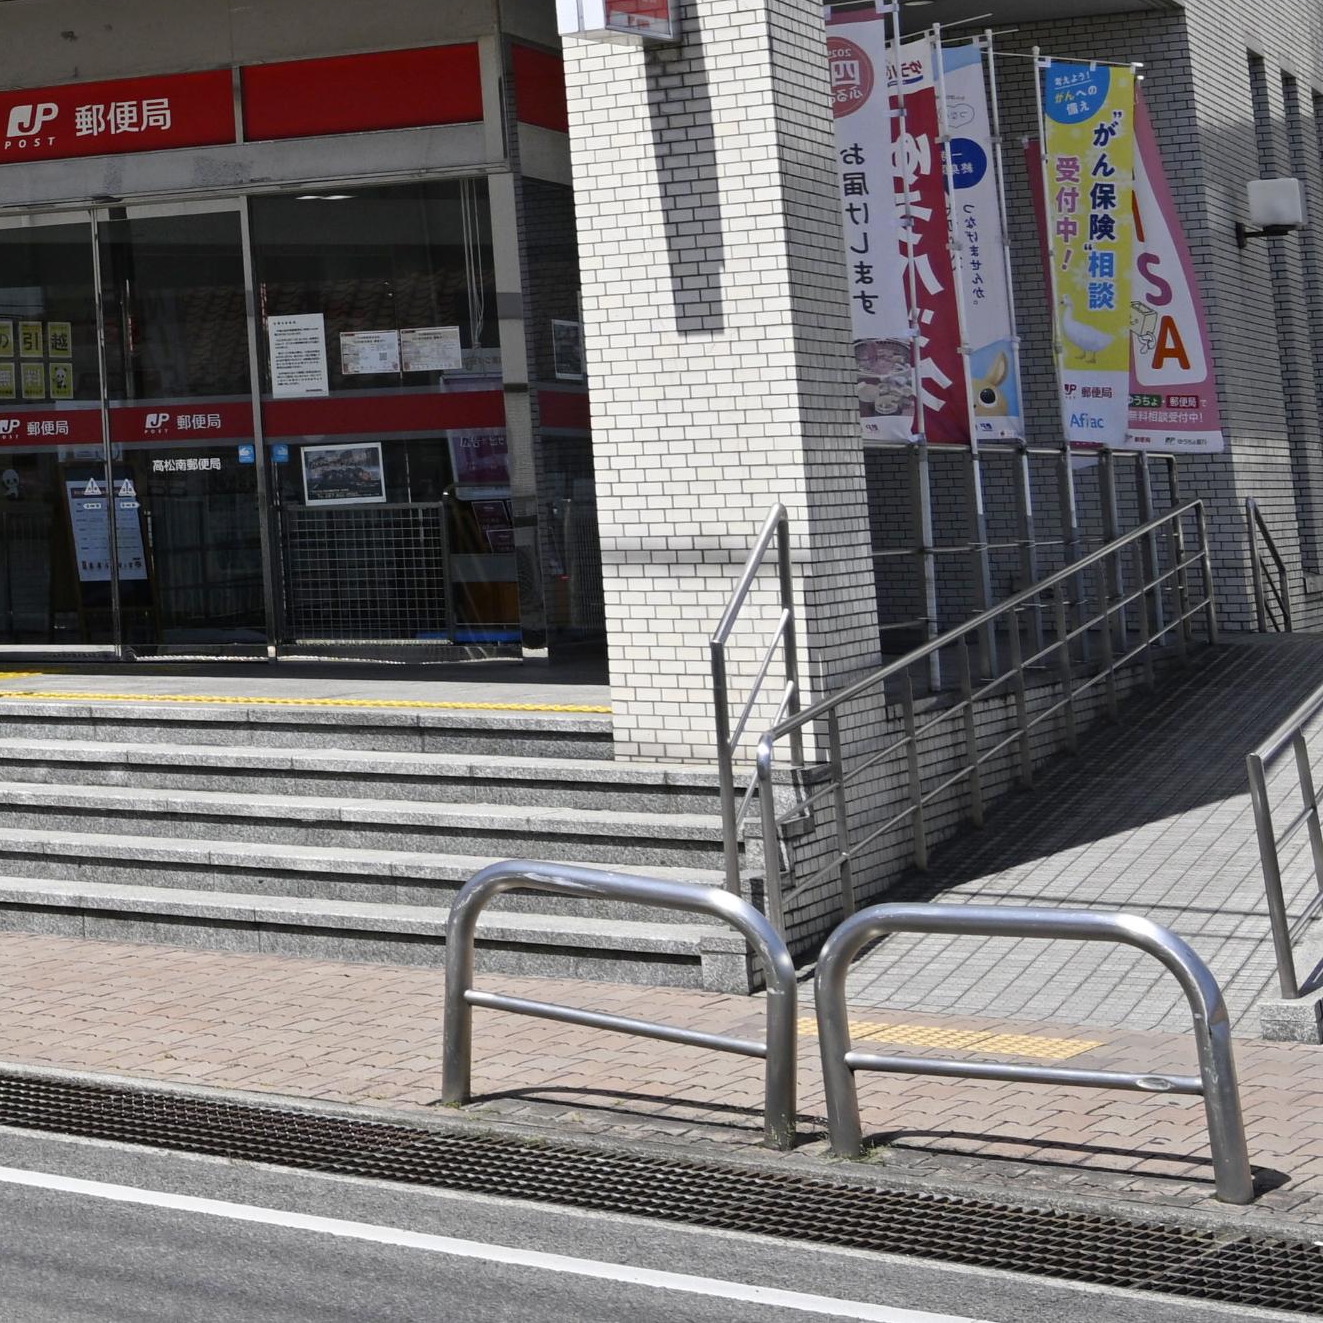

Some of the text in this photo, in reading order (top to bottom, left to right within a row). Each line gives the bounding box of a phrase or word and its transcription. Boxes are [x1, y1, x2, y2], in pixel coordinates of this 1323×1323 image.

[7, 102, 59, 138] JP
[75, 98, 171, 137] 郵便局
[4, 136, 56, 150] POST
[1055, 157, 1080, 271] 受付中！
[1131, 168, 1191, 370] ISA
[1081, 387, 1113, 398] 郵便局
[26, 420, 69, 436] 郵便局
[176, 413, 222, 430] 郵便局
[152, 458, 222, 472] 高松南郵便局
